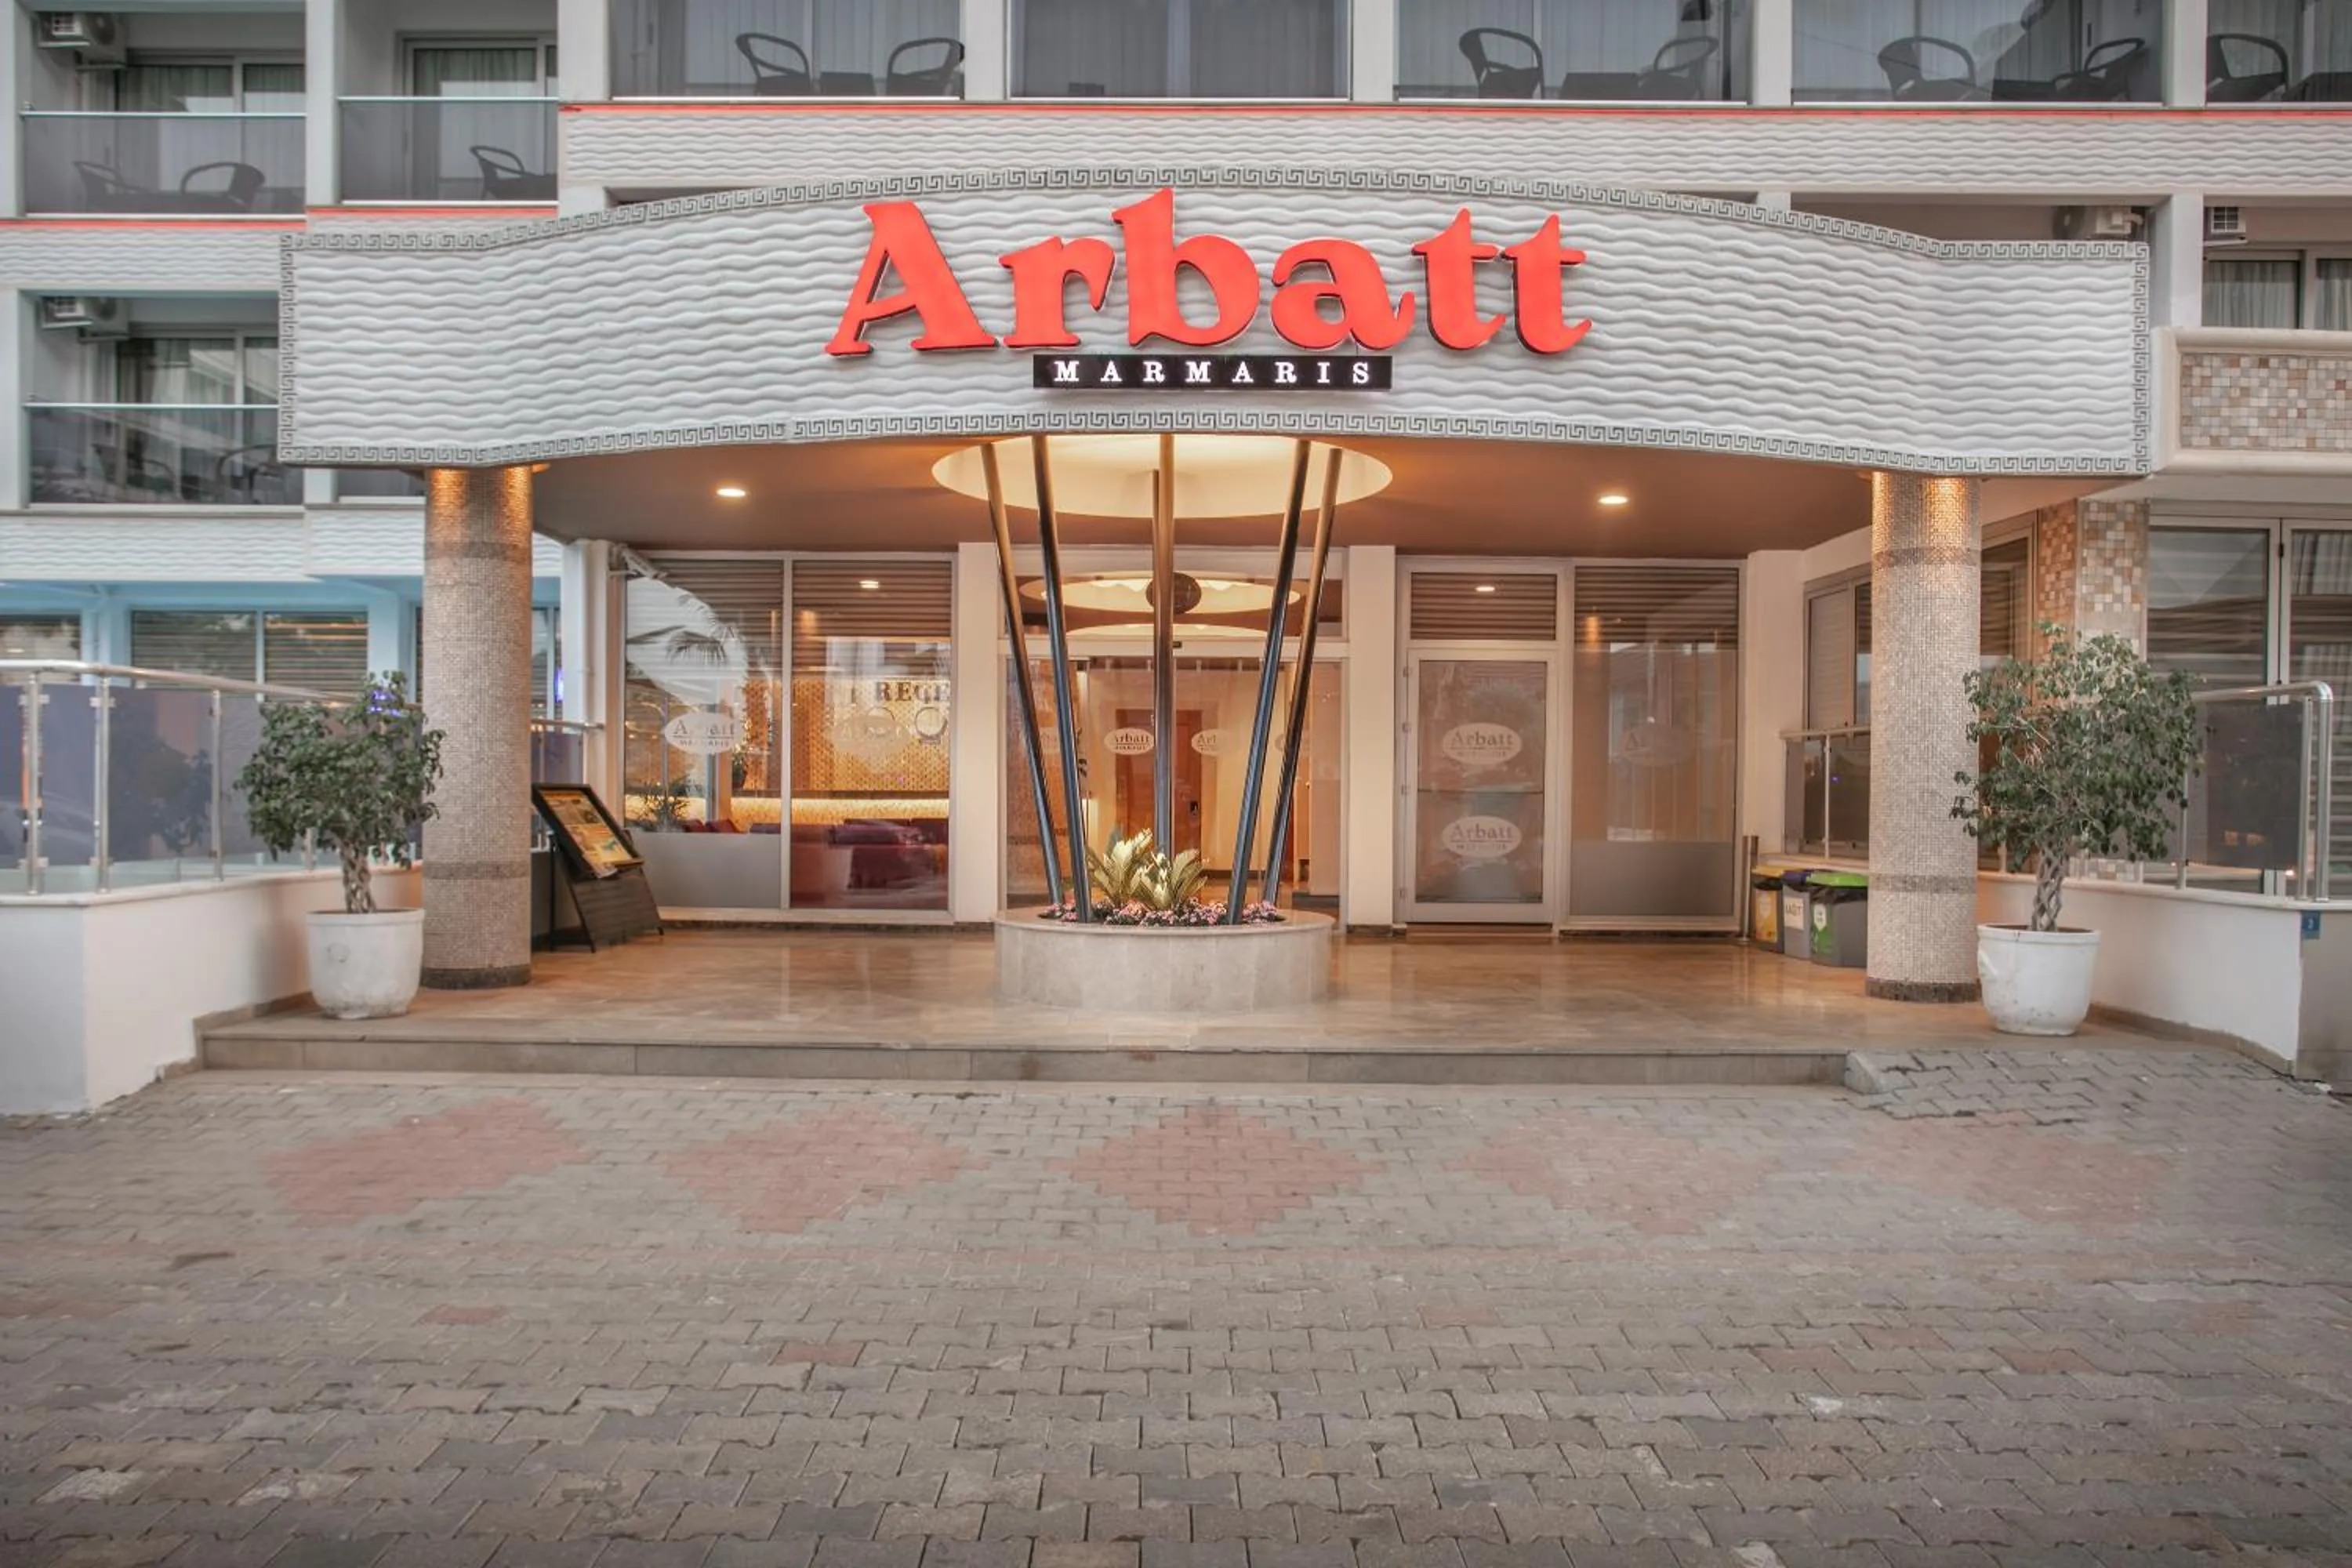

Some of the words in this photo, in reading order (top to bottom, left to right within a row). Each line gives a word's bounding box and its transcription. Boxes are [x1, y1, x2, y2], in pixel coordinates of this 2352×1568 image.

[825, 187, 1592, 354] Arbatt
[1053, 361, 1369, 383] MARMARIS
[1450, 731, 1514, 746] Arbatt
[1450, 824, 1513, 839] Arbatt
